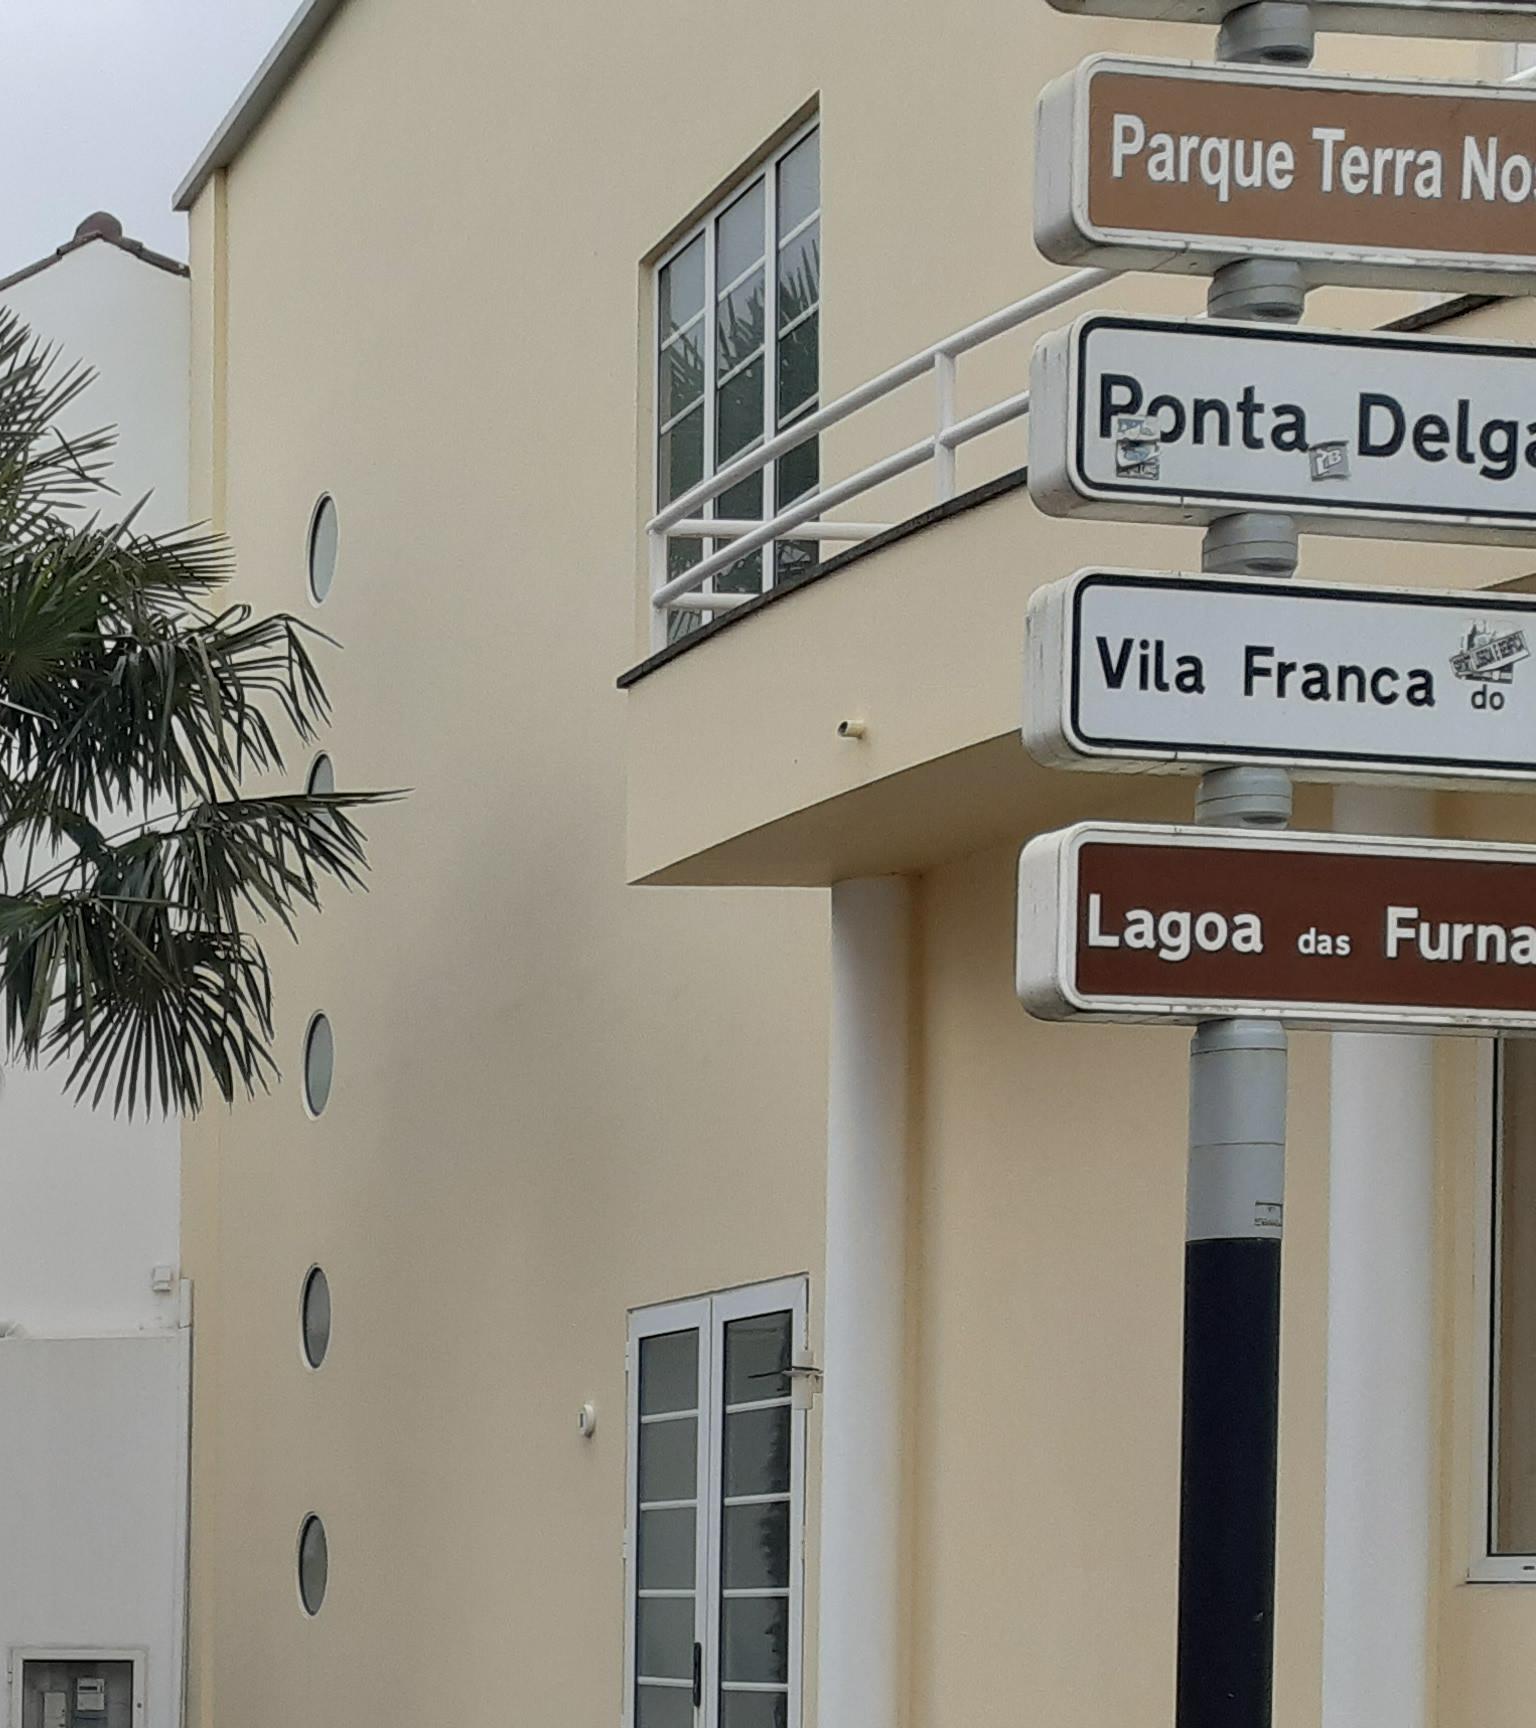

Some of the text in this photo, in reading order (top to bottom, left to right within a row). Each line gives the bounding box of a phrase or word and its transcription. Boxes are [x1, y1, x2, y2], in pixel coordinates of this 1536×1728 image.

[1111, 113, 1536, 203] Parque Terra No
[1099, 373, 1536, 481] Ponta Delg
[1096, 636, 1206, 695] Vila
[1243, 645, 1436, 707] Franca
[1470, 683, 1505, 710] do
[1087, 893, 1264, 962] Lagoa
[1297, 928, 1351, 957] das
